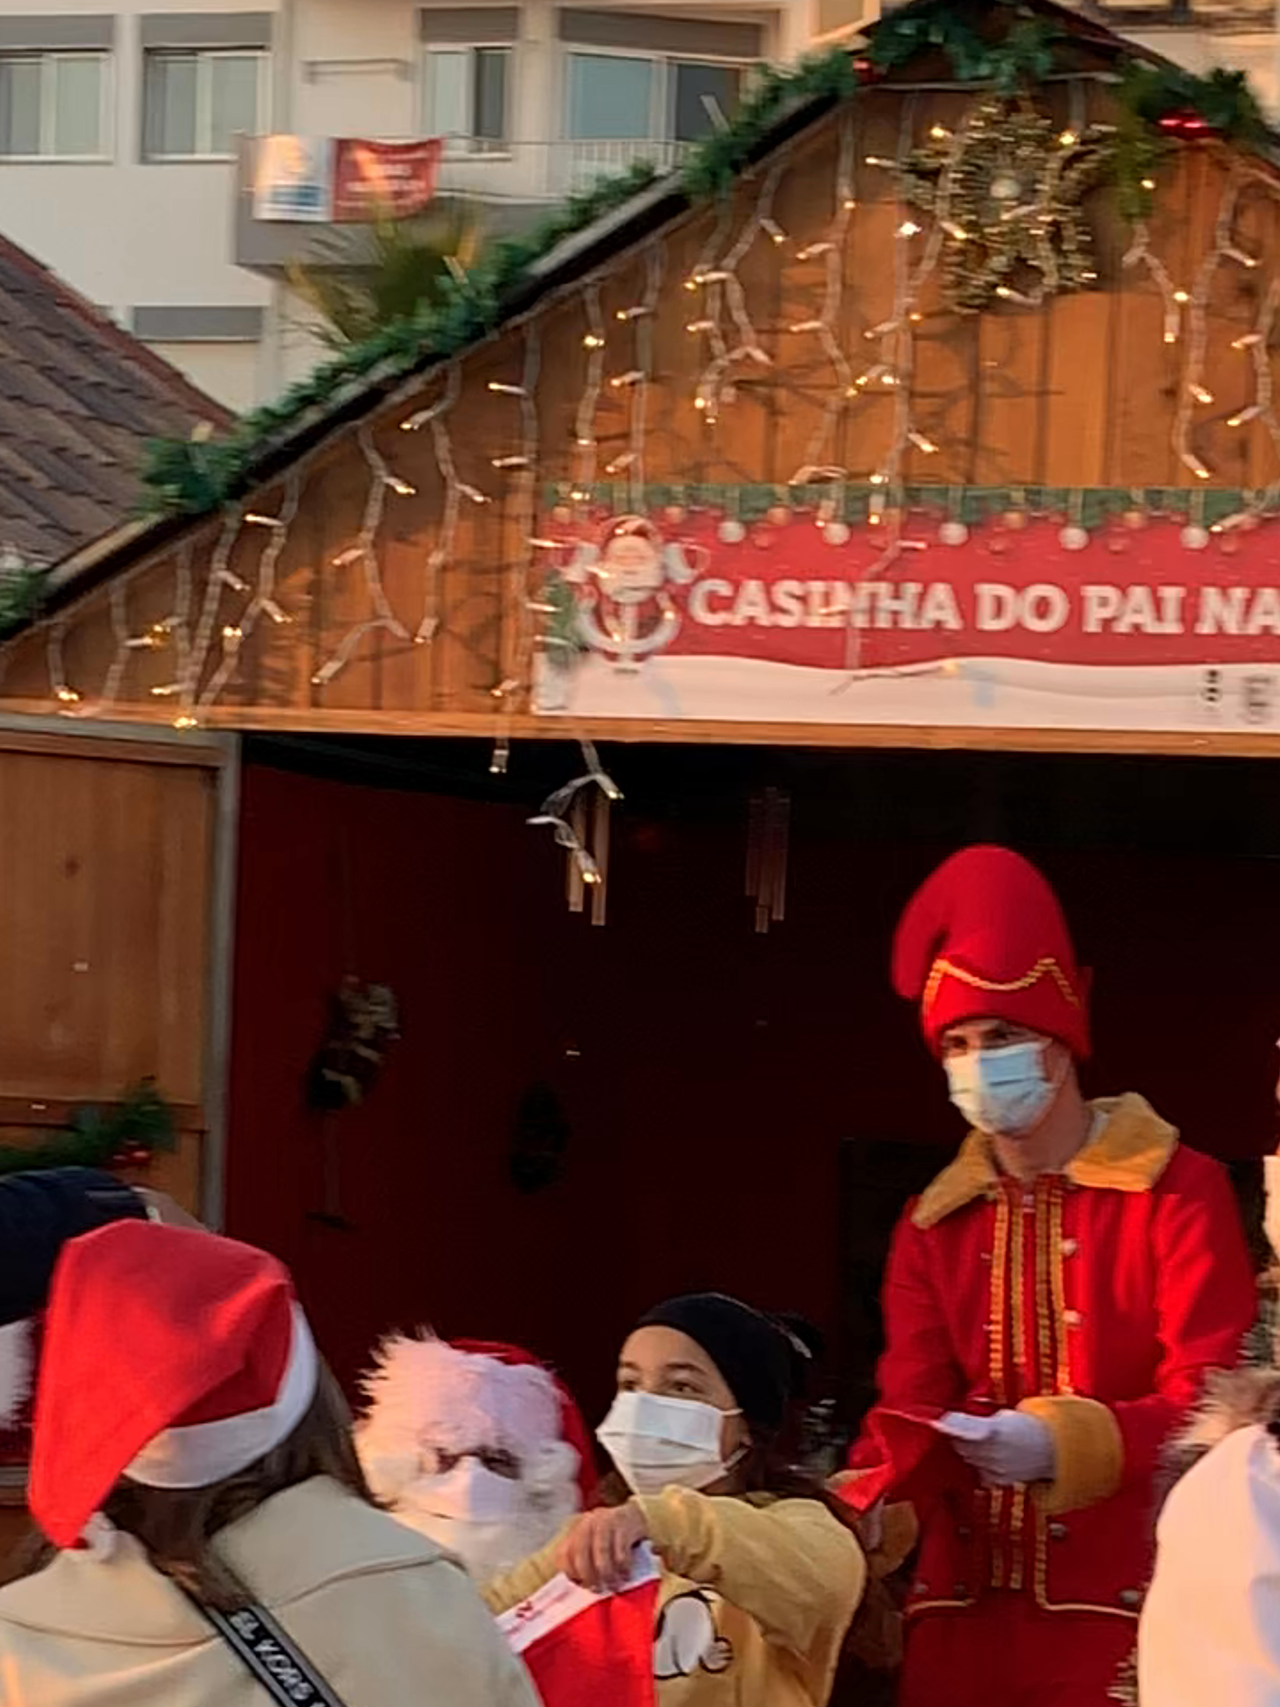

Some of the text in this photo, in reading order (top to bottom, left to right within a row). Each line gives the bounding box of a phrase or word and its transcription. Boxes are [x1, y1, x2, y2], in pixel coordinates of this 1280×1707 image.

[687, 578, 963, 630] CASINHA
[973, 582, 1069, 633] DO
[1080, 584, 1187, 634] PAI
